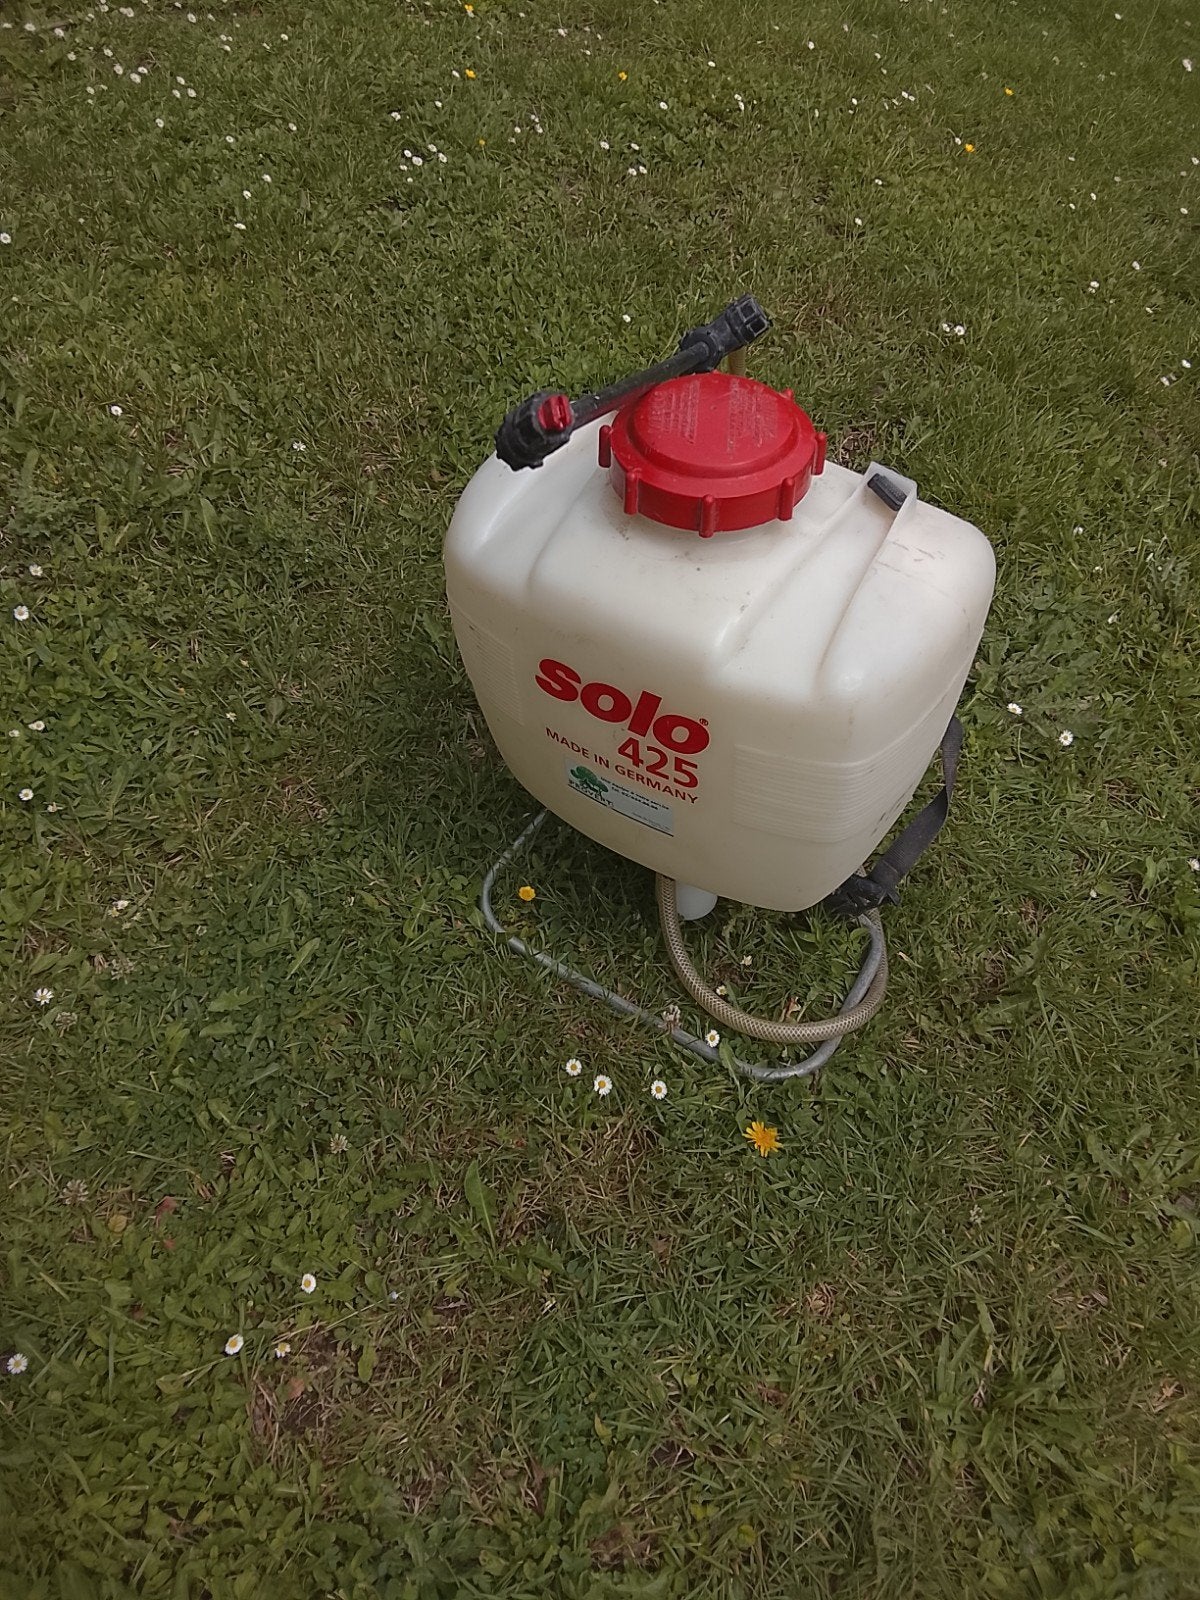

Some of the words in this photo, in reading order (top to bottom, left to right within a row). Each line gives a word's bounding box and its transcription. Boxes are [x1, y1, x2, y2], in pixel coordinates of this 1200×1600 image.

[535, 658, 710, 754] solo
[545, 727, 590, 759] MADE
[594, 753, 610, 769] IN
[614, 765, 700, 804] GERMANY
[618, 737, 698, 788] 425
